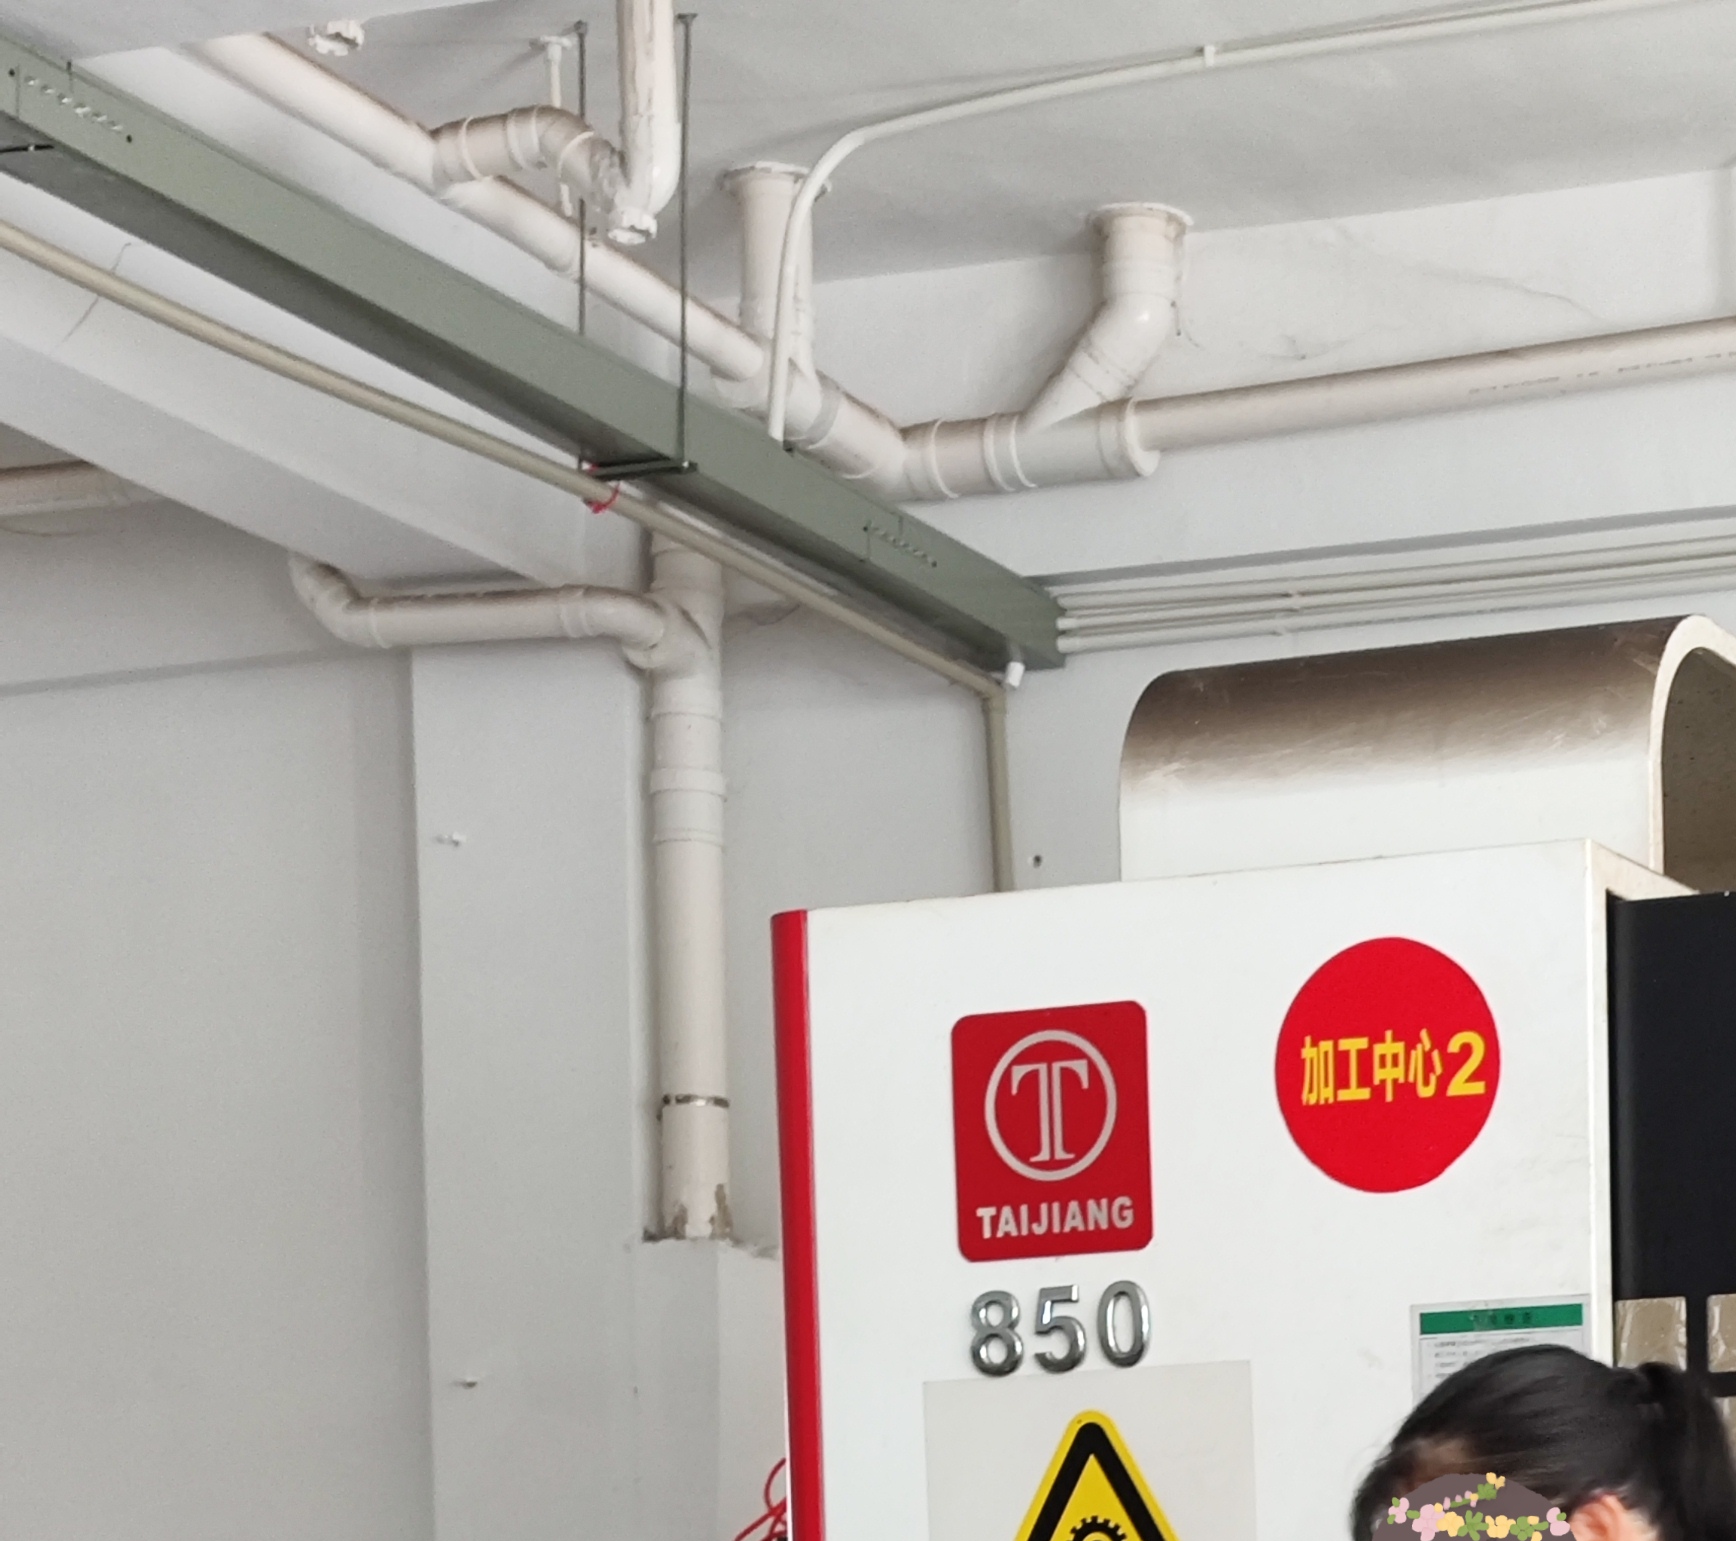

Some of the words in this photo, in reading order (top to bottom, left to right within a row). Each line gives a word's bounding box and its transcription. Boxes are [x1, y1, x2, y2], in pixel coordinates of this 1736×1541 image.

[1301, 1028, 1486, 1106] 加工中心2
[976, 1195, 1135, 1239] TAIJIANG
[969, 1280, 1151, 1377] 850
